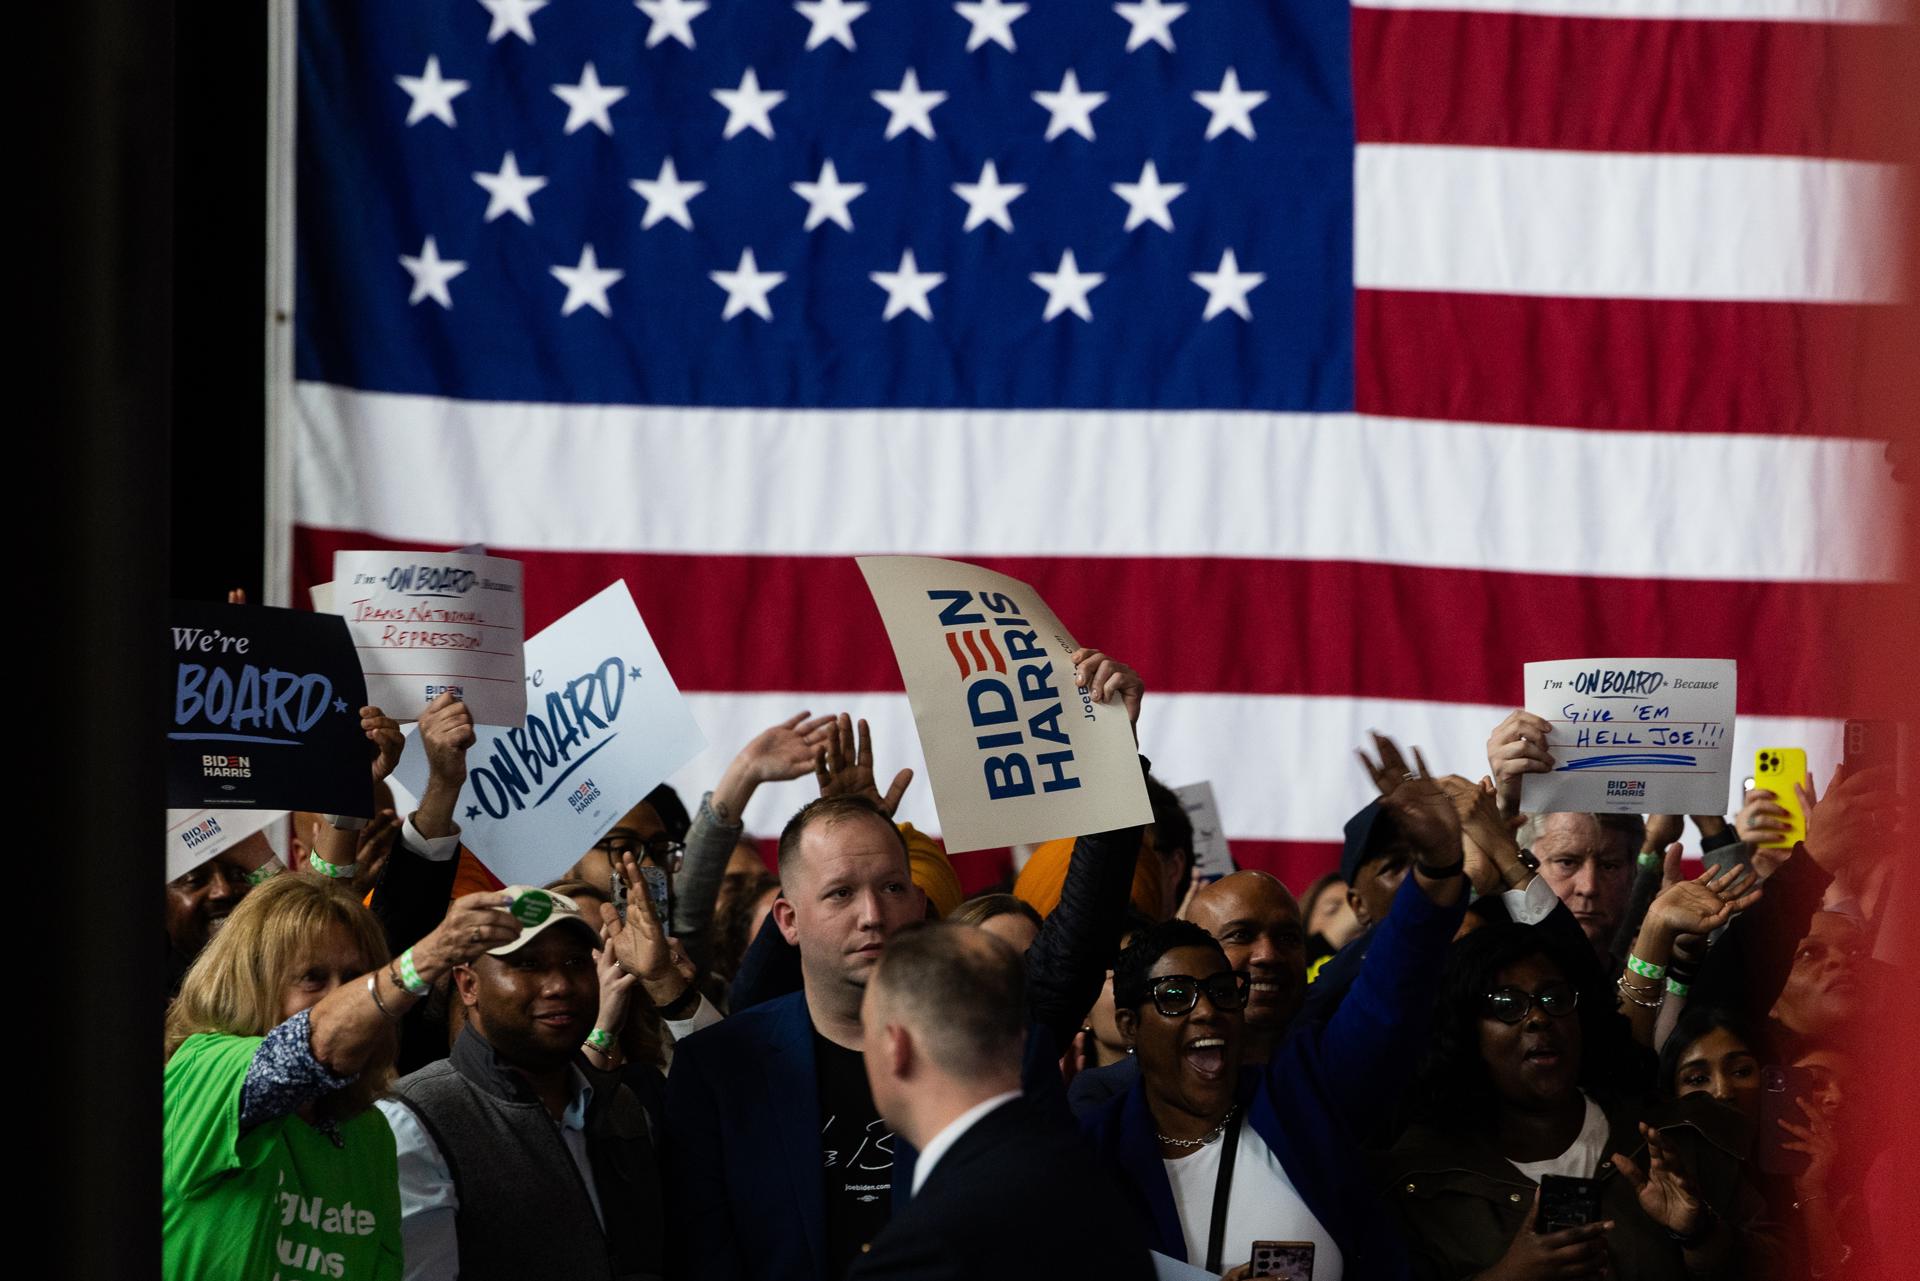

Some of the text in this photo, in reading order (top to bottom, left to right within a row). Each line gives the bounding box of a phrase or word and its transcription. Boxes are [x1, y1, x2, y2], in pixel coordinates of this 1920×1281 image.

[171, 627, 250, 654] We're
[425, 685, 465, 695] BIDEN
[978, 591, 1081, 793] HARRIS
[1543, 679, 1563, 690] I'm
[1672, 678, 1719, 690] Because
[175, 662, 333, 734] BOARD
[926, 590, 1037, 801] BIDEN
[1562, 703, 1614, 724] Give
[1576, 727, 1642, 748] HELL
[202, 755, 251, 768] BIDEN
[203, 767, 252, 778] HARRIS
[568, 778, 596, 807] BIDEN
[1606, 789, 1646, 798] HARRIS
[1607, 780, 1647, 790] BIDEN
[575, 787, 602, 815] HARRIS
[181, 816, 218, 843] BIDEN
[186, 825, 222, 849] HARRIS
